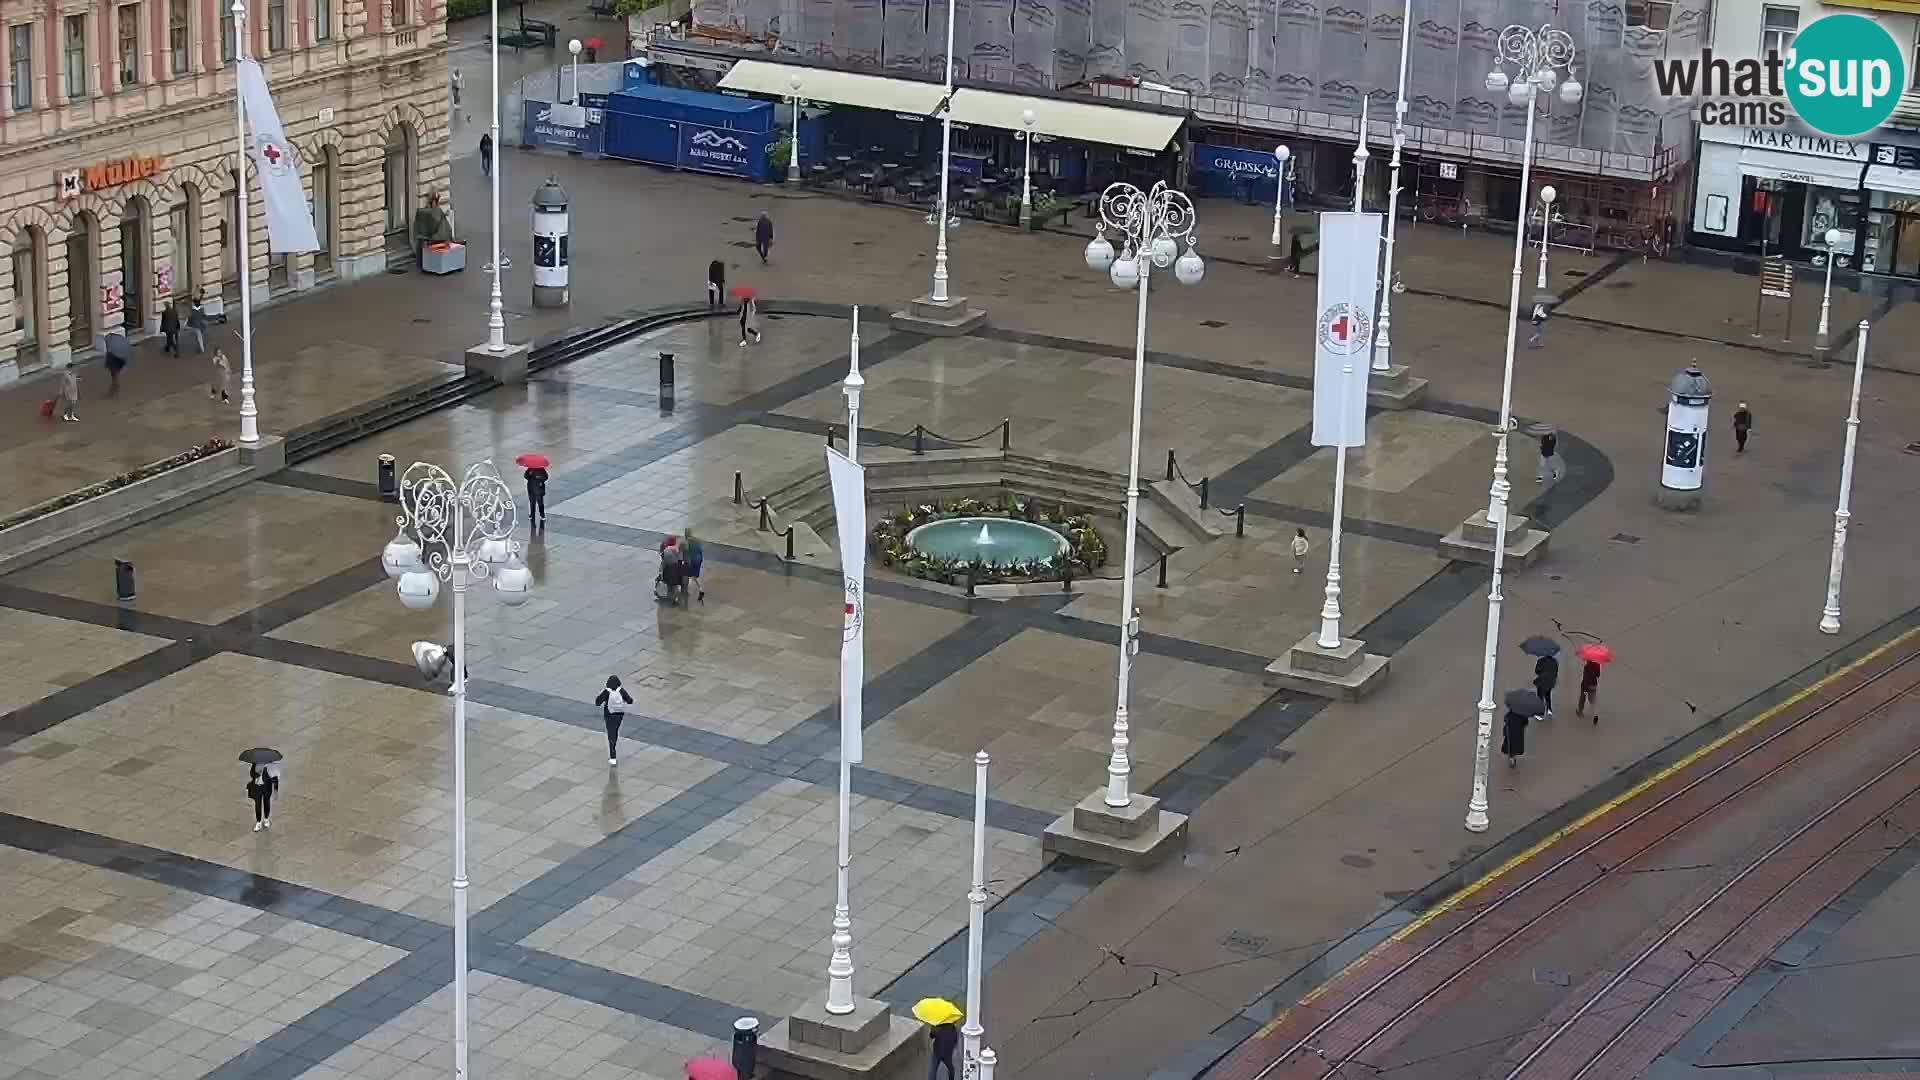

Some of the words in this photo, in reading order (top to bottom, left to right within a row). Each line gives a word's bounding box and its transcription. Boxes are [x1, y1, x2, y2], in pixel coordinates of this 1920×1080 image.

[1748, 129, 1858, 157] MARTIMEX
[83, 154, 161, 191] Müller
[1214, 157, 1270, 175] GRADSKA
